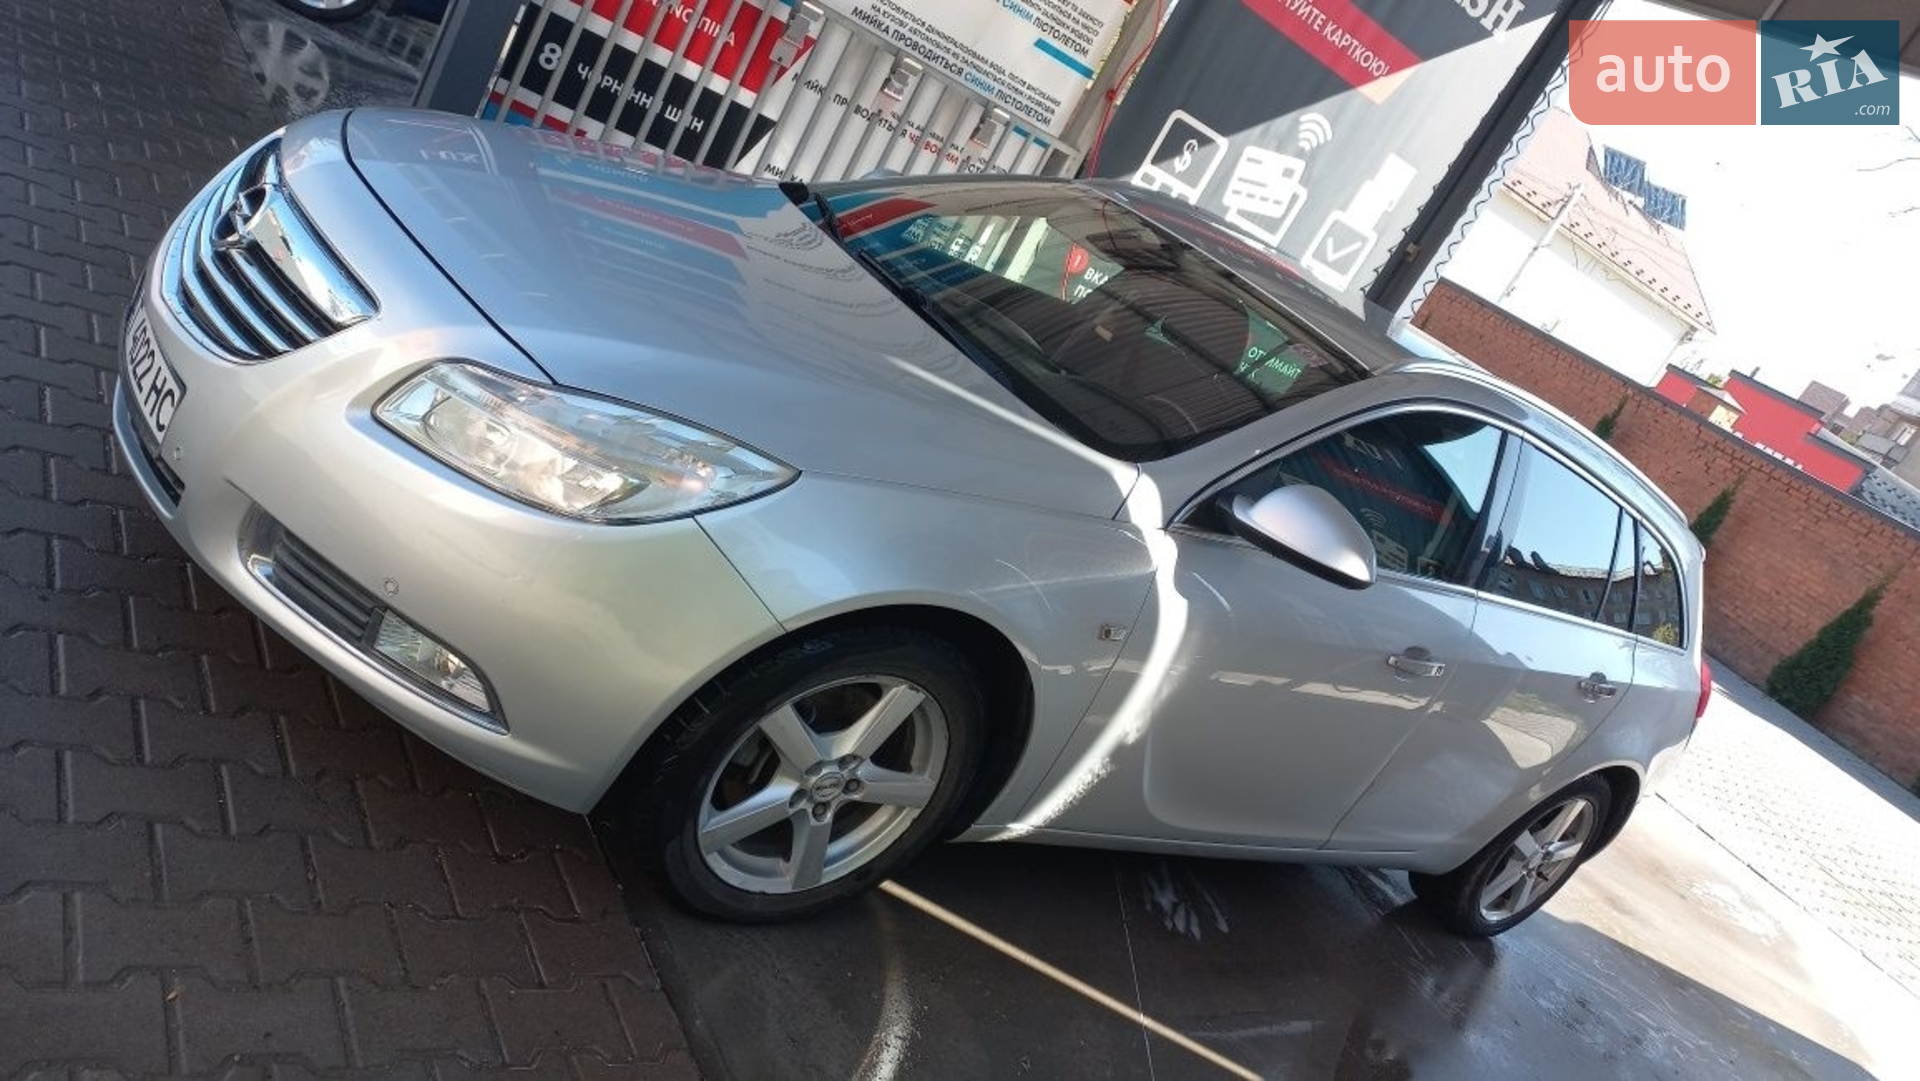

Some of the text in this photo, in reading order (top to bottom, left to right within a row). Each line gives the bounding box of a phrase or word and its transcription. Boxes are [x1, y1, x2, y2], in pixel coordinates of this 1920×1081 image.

[538, 42, 563, 71] 8
[1032, 17, 1089, 57] ПІСТОЛЕТОМ
[1323, 20, 1390, 77] КАРТКОЮ!
[851, 6, 1052, 127] МИЙКА ПРОВОДИТЬСЯ СИНІМ ПІСТОЛЕТОМ
[664, 104, 704, 132] ШН
[144, 366, 175, 432] HC
